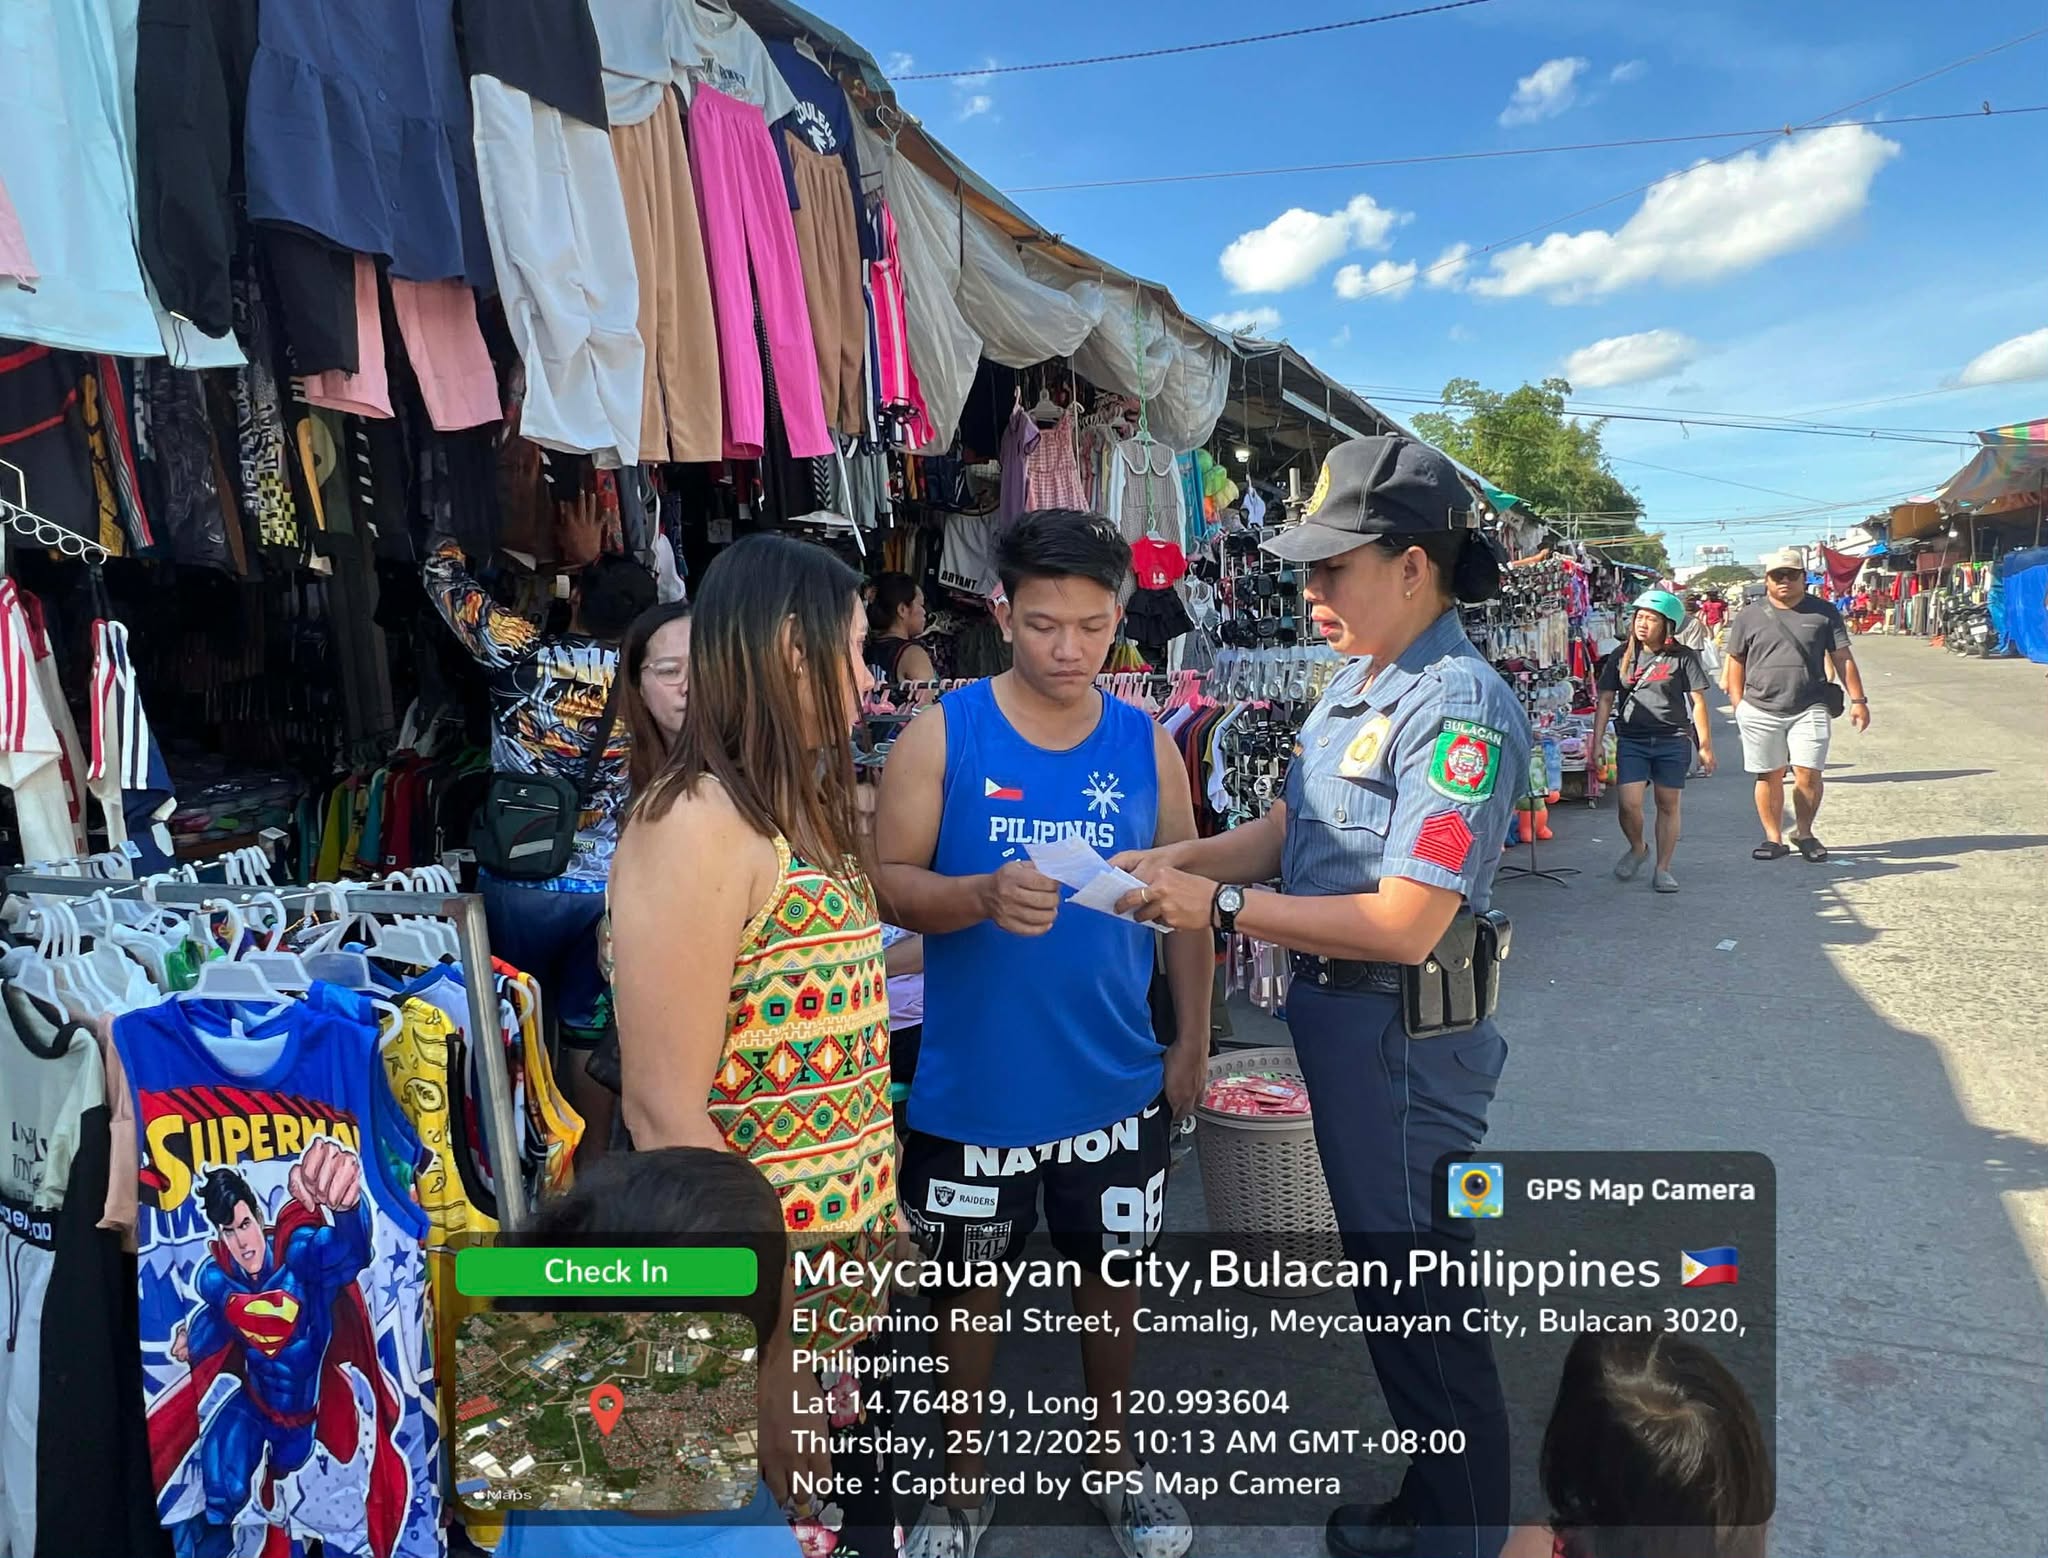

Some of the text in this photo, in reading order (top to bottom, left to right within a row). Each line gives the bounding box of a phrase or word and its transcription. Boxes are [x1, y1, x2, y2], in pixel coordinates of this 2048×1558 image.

[1443, 720, 1502, 745] BULACAN
[989, 816, 1115, 848] PILIPINAS
[963, 1117, 1139, 1177] NATION
[960, 1195, 996, 1206] RAIDERS
